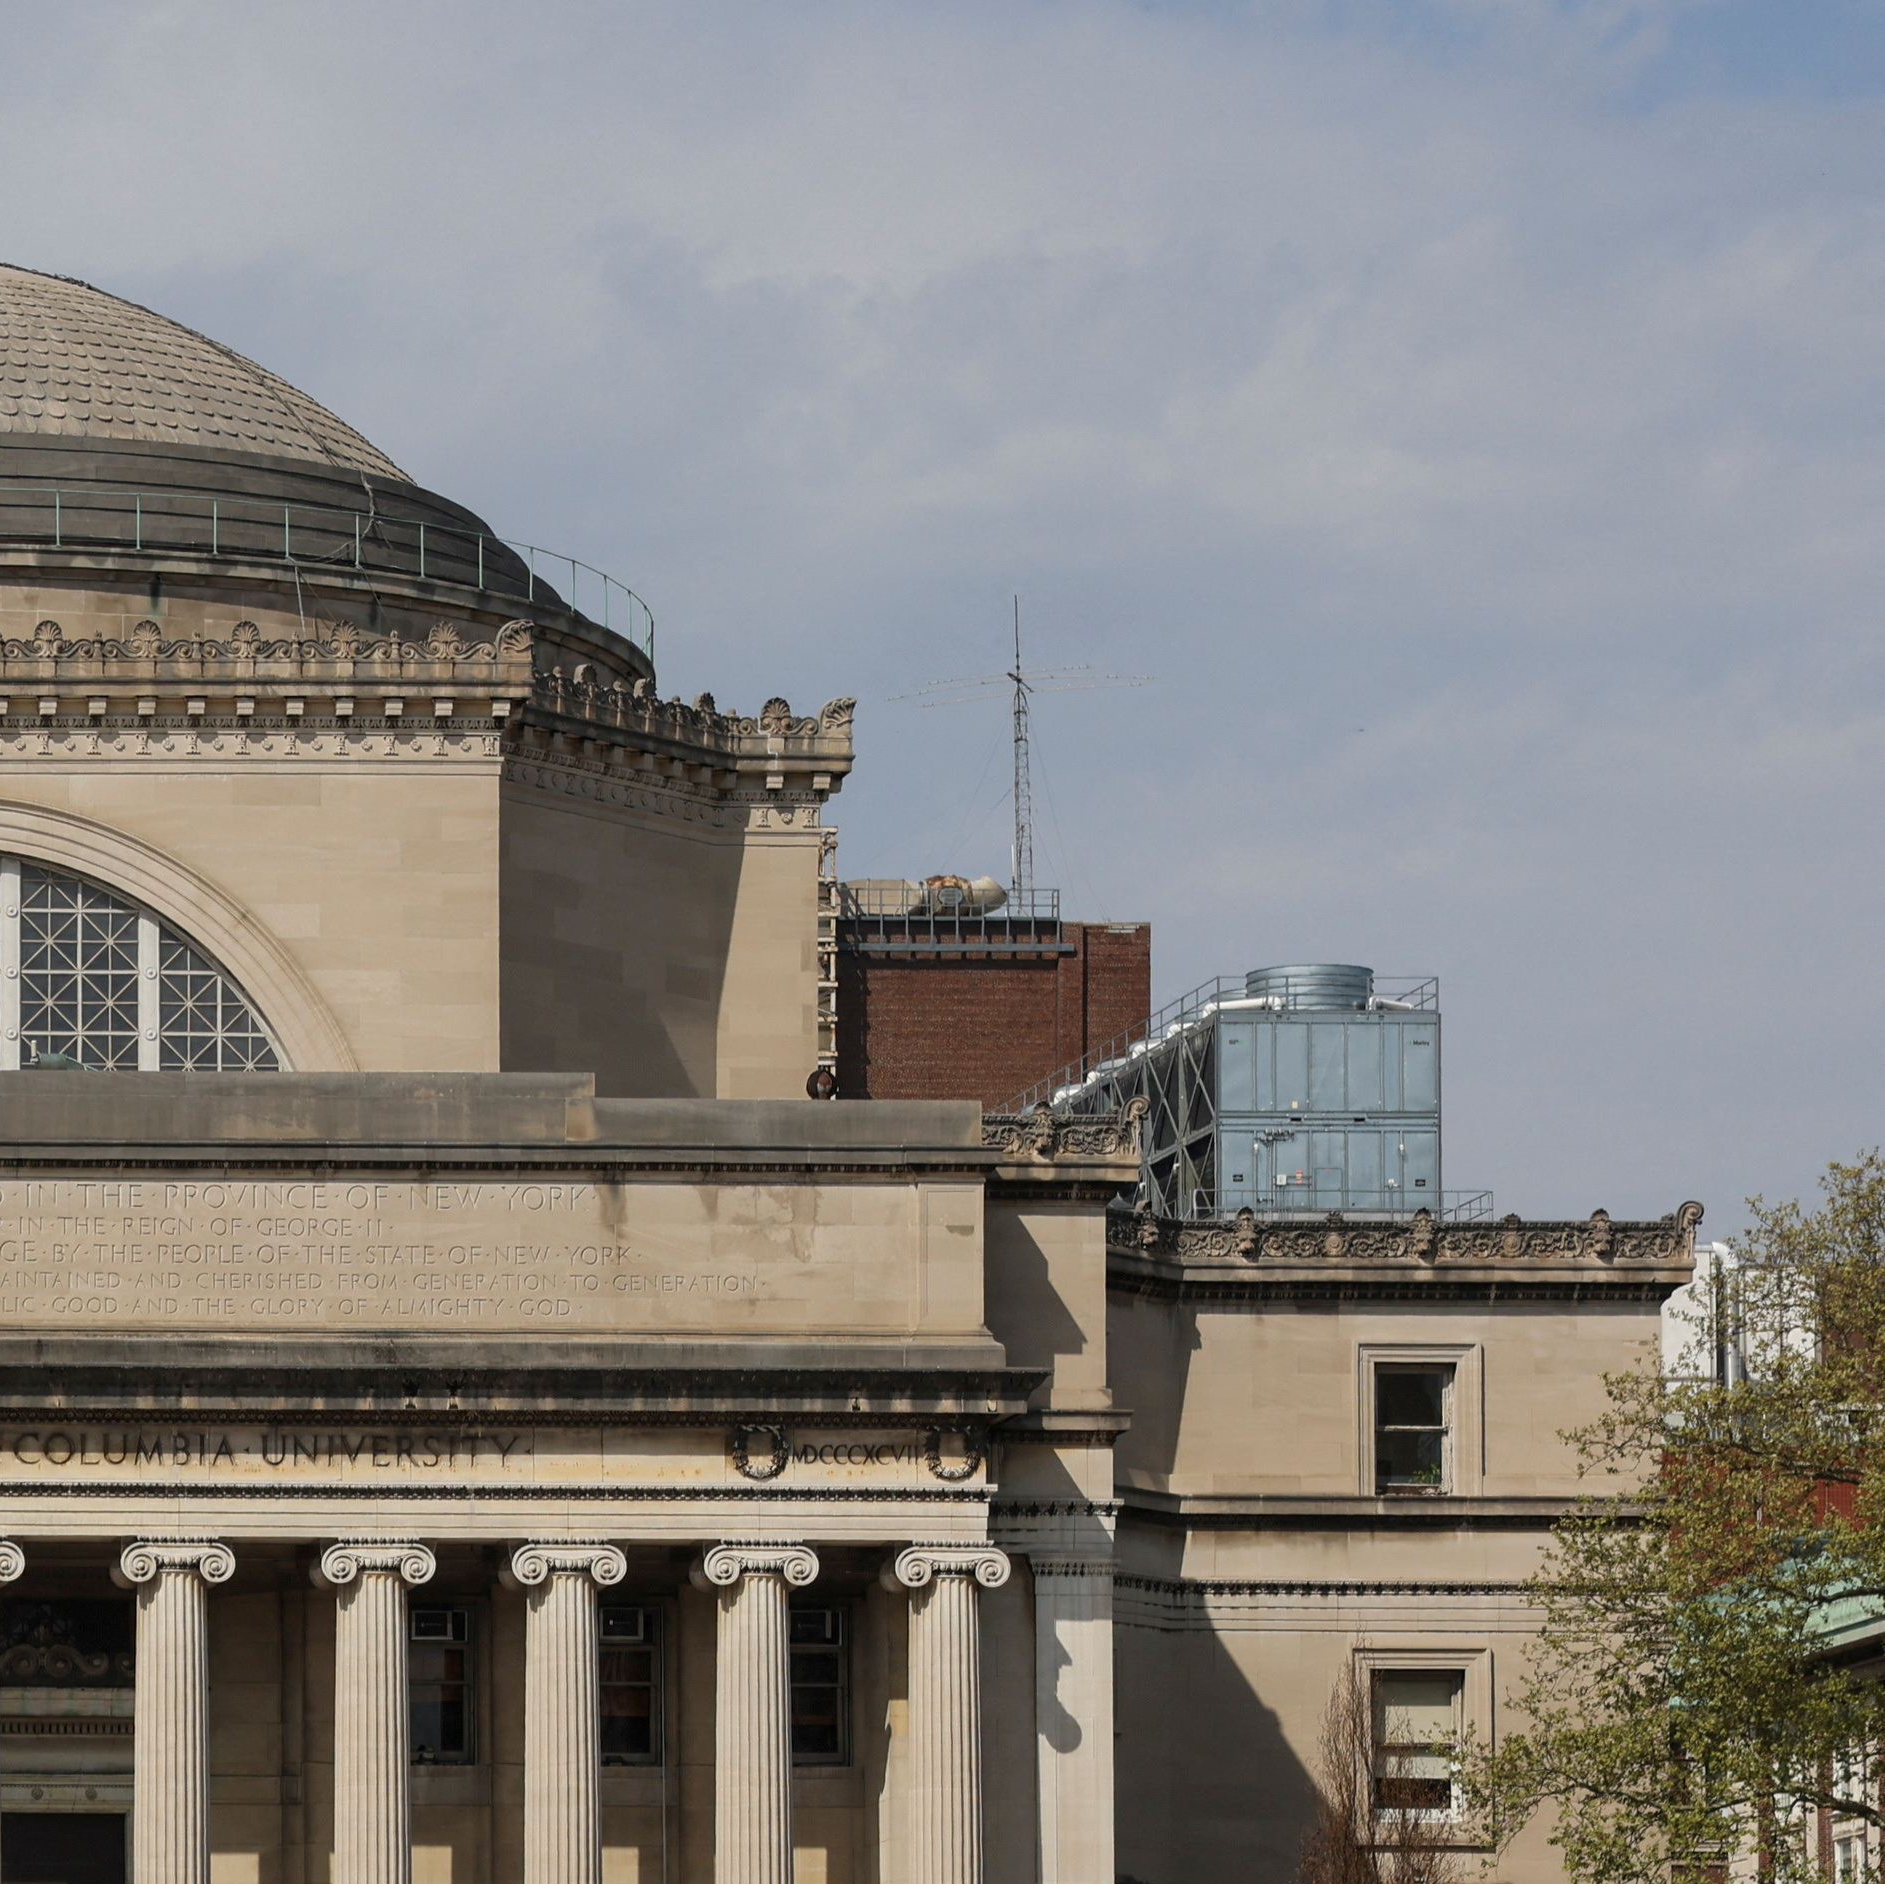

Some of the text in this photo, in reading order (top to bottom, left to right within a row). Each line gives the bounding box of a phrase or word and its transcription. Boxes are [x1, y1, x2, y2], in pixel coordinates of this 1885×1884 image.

[24, 1183, 58, 1208] IN
[77, 1183, 145, 1209] THE
[164, 1184, 329, 1210] PROVINCE
[345, 1185, 389, 1210] OF
[409, 1186, 483, 1211] NEW
[501, 1186, 590, 1212] YORK
[19, 1216, 43, 1235] IN
[57, 1216, 105, 1235] THE
[122, 1217, 193, 1236] REIGN
[209, 1217, 243, 1237] OF
[256, 1218, 352, 1237] GEORGE
[366, 1218, 383, 1237] II
[52, 1243, 80, 1264] BY
[93, 1243, 144, 1264] THE
[156, 1244, 245, 1265] PEOPLE
[256, 1244, 293, 1265] OF
[303, 1245, 353, 1265] THE
[364, 1245, 437, 1266] STATE
[448, 1246, 486, 1266] OF
[494, 1246, 551, 1267] NEW
[566, 1246, 634, 1267] YORK
[133, 1271, 183, 1290] AND
[195, 1272, 323, 1290] CHERISHED
[337, 1273, 400, 1291] FROM
[412, 1273, 558, 1292] GENERATION
[569, 1274, 600, 1292] TO
[612, 1274, 758, 1293] GENERATION
[51, 1297, 119, 1315] GOOD
[130, 1298, 180, 1315] AND
[190, 1298, 237, 1316] THE
[249, 1298, 326, 1317] GLORY
[337, 1299, 369, 1316] OF
[380, 1299, 505, 1317] ALMIGHTY
[518, 1299, 573, 1317] GOD
[12, 1432, 238, 1467] COLUMBIA
[259, 1433, 522, 1470] UNIVERSITY
